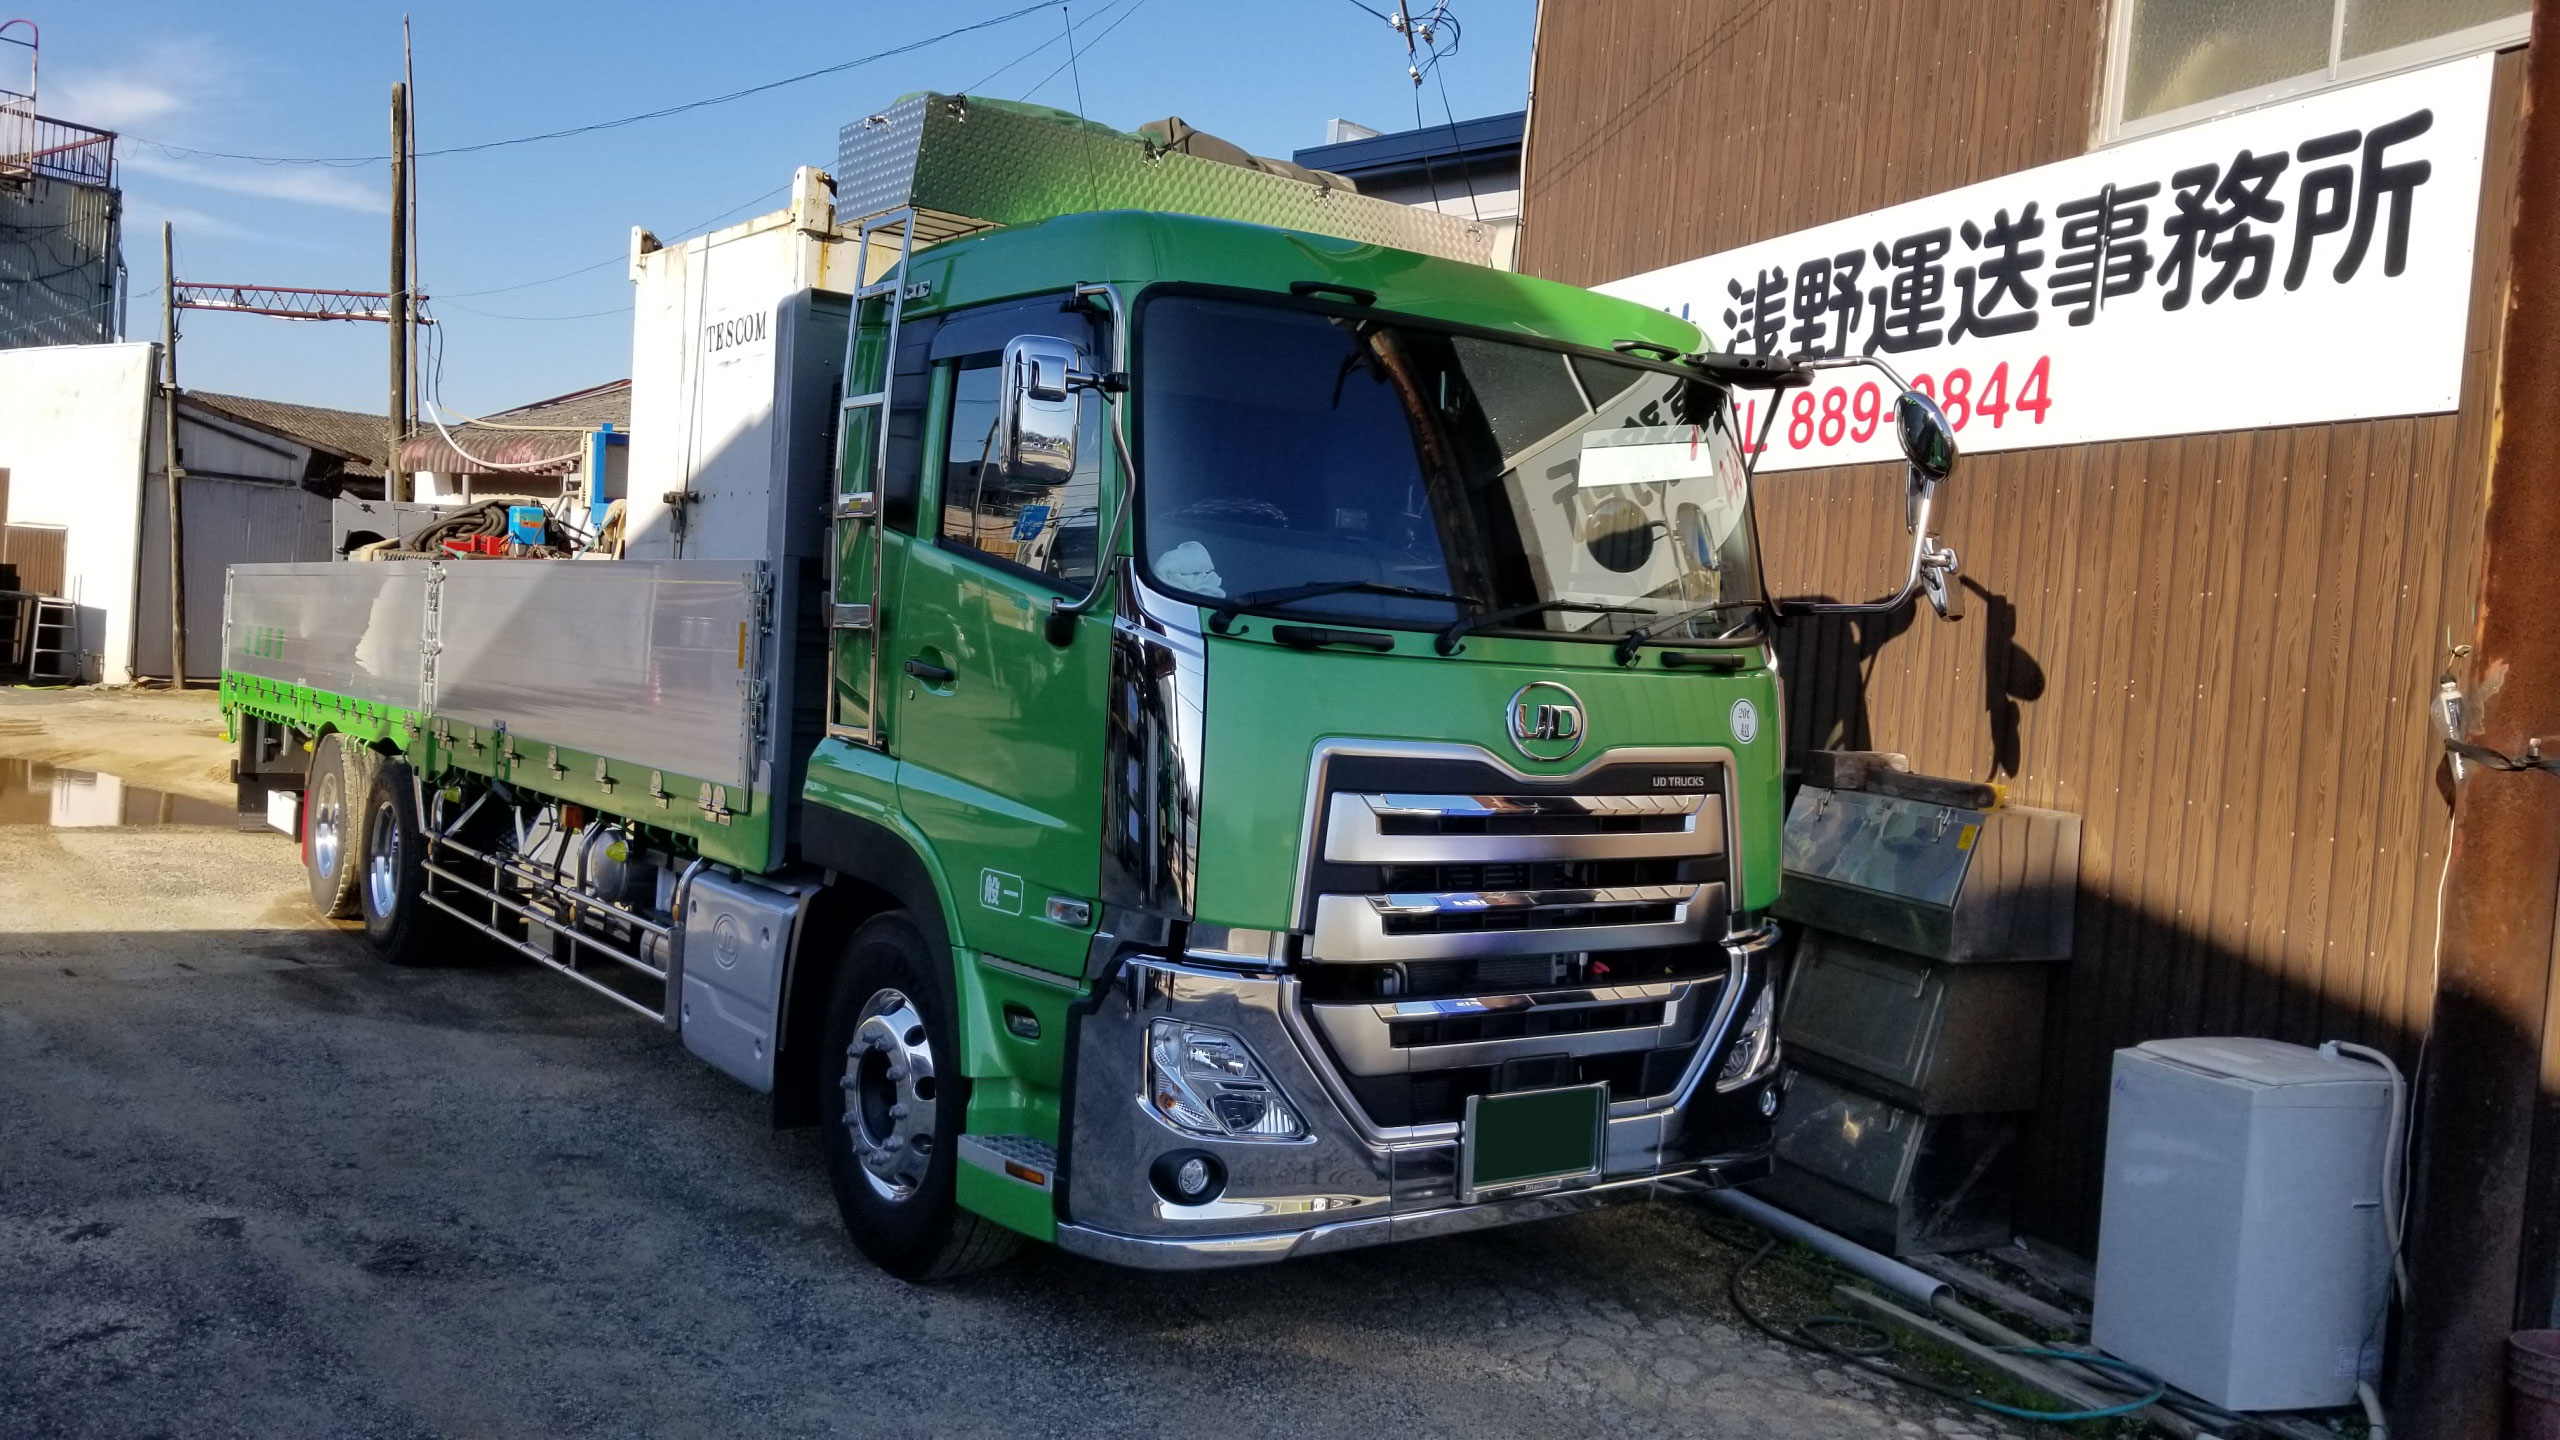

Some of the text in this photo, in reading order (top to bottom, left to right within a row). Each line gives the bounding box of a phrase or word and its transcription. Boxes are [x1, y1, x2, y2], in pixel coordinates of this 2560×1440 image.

[706, 310, 767, 353] TESCOM
[1516, 703, 1583, 740] UD
[1653, 776, 1704, 787] UD TRUCKS
